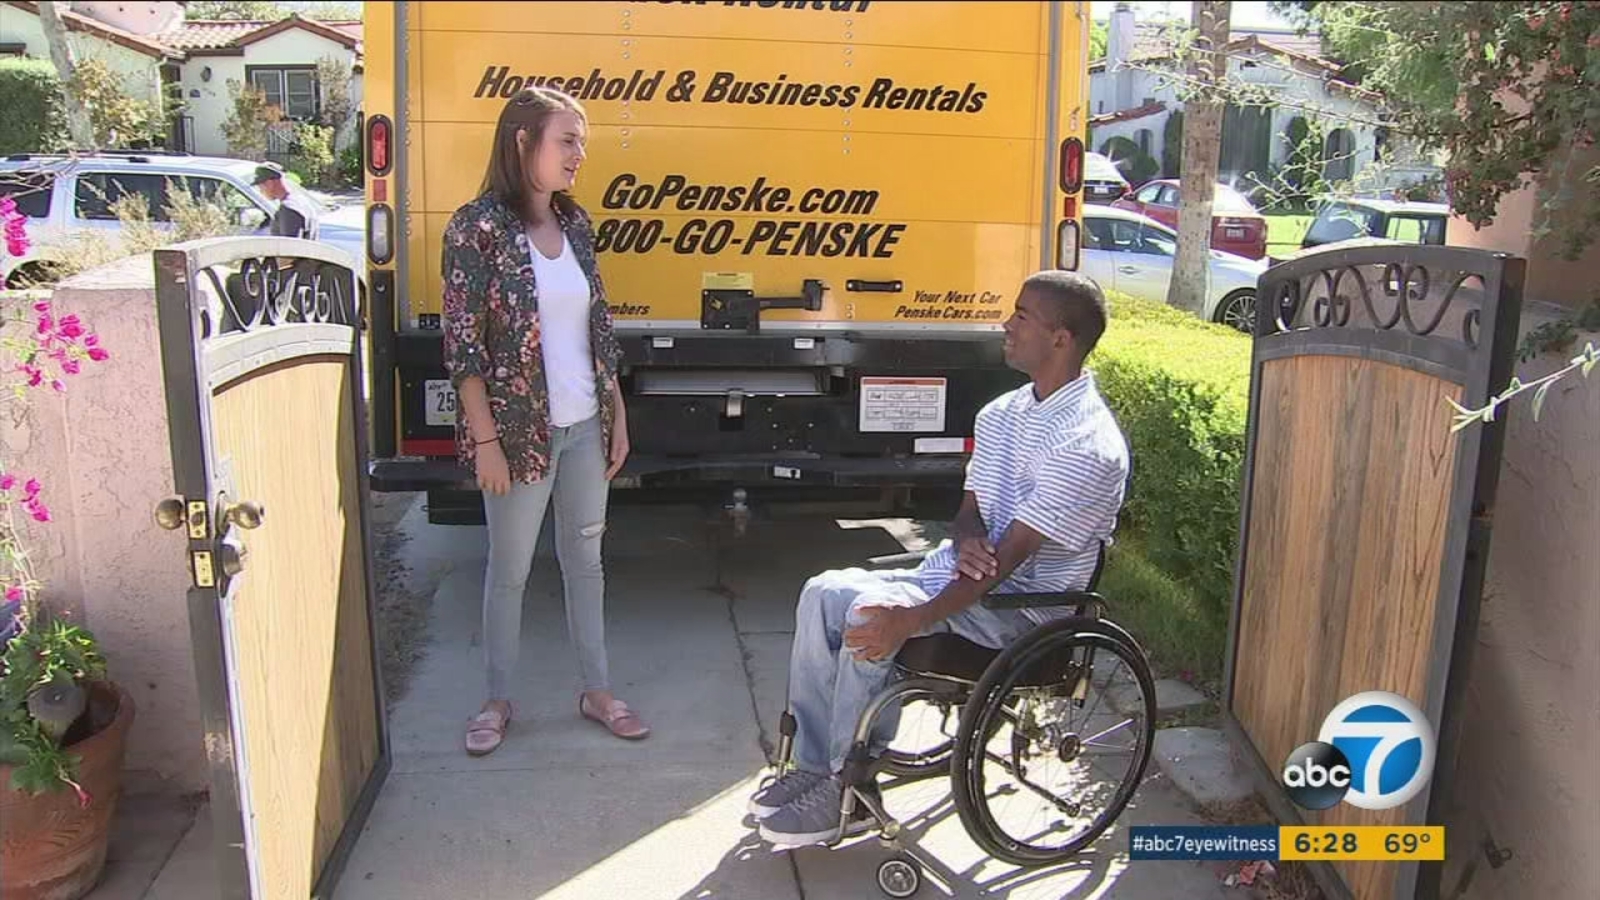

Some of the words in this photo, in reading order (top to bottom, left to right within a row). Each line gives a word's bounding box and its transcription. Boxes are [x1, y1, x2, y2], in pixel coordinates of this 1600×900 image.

[474, 66, 665, 101] Household
[666, 70, 696, 102] &
[703, 72, 861, 107] Business
[862, 78, 987, 113] Rentals
[602, 173, 879, 215] GoPenske.com
[914, 290, 942, 304] Your
[943, 291, 976, 304] Next
[980, 291, 1002, 304] Car
[437, 391, 455, 412] 25
